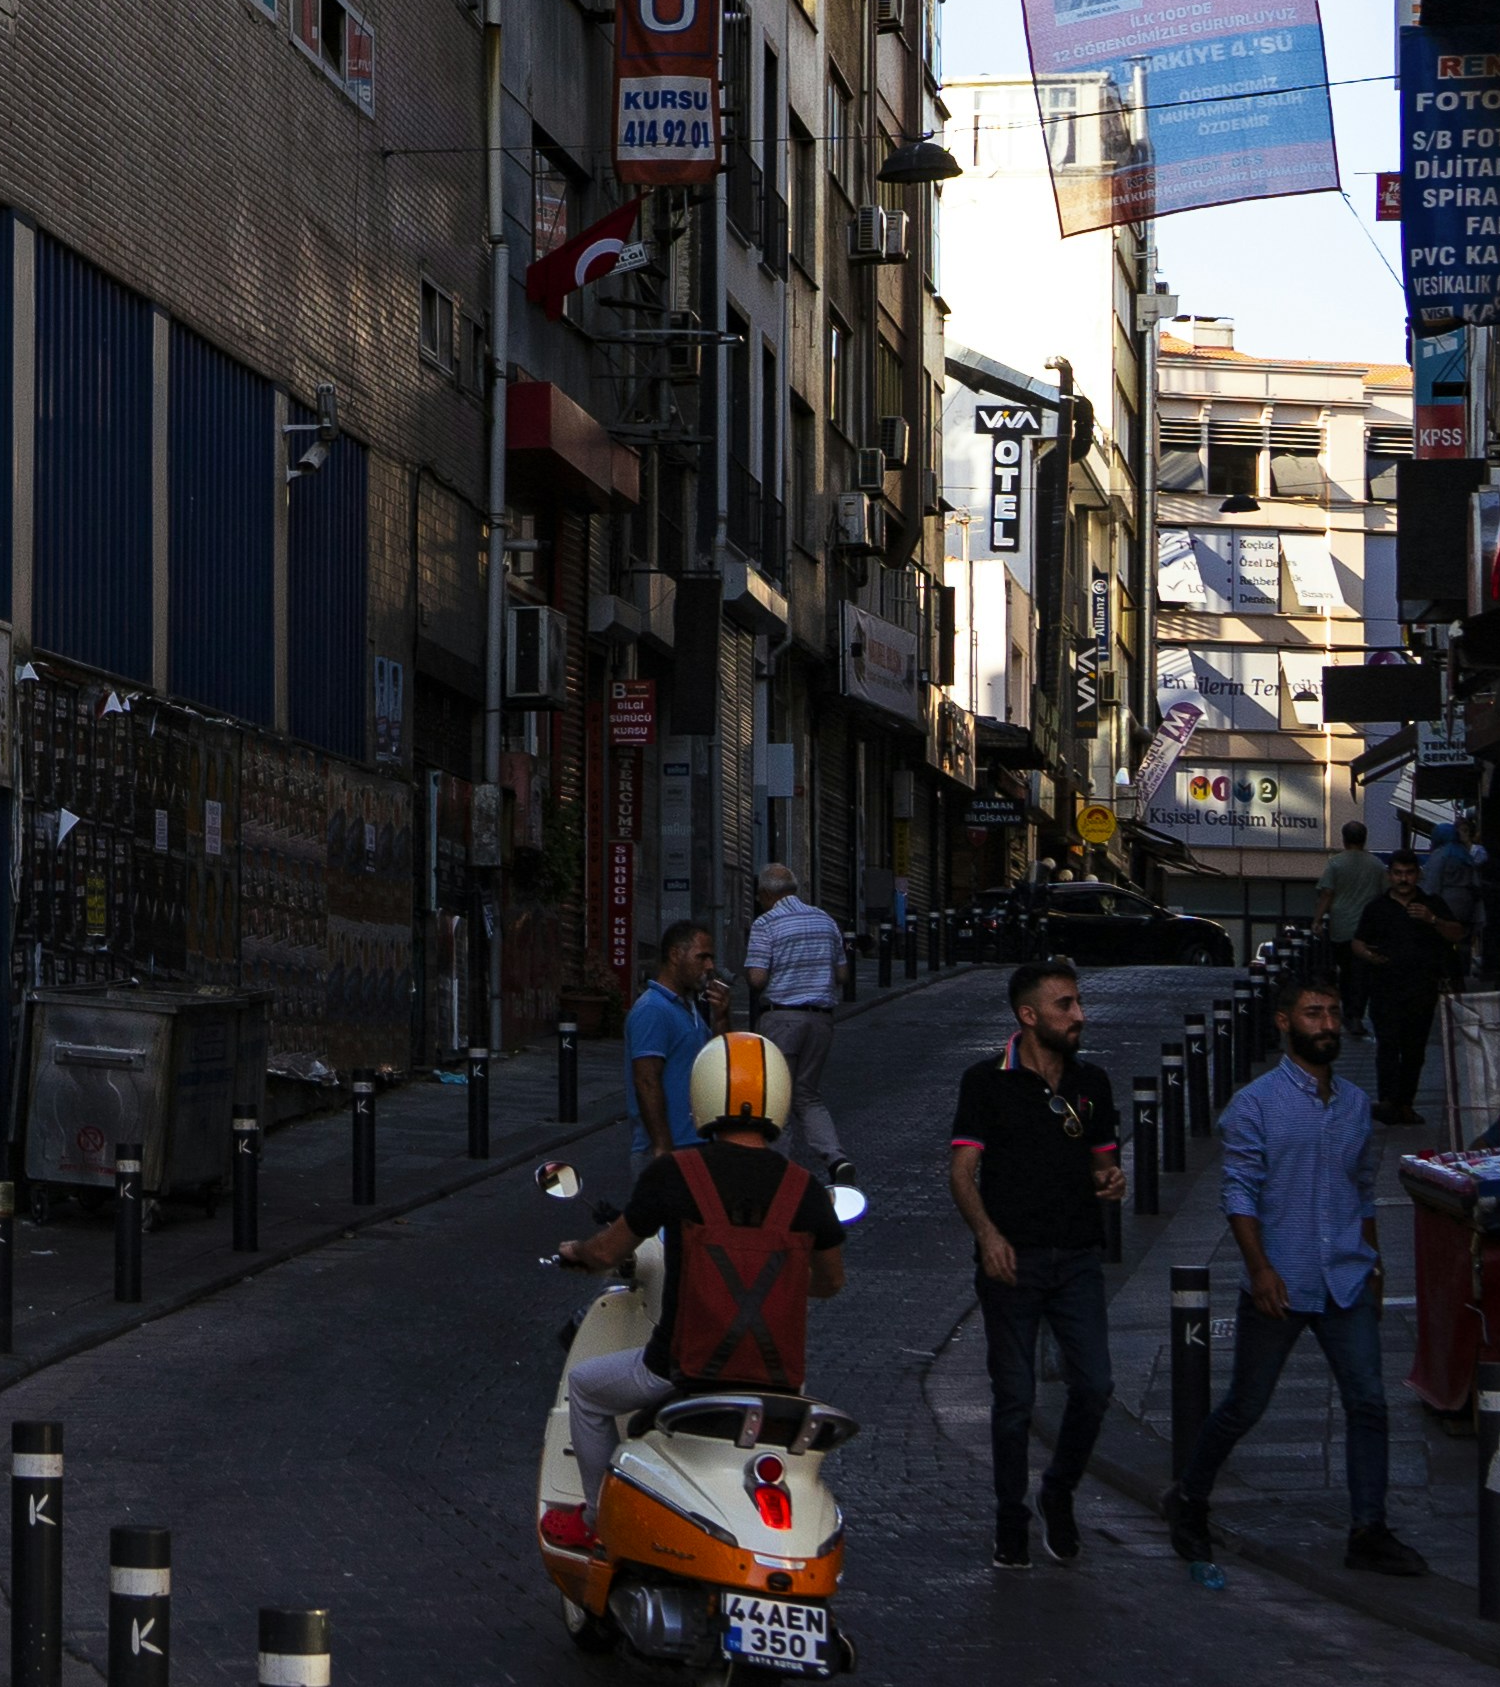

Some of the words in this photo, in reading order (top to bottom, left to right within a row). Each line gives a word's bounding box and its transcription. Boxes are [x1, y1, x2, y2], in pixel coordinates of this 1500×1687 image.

[1131, 10, 1154, 28] İLK
[624, 90, 708, 110] KURSU
[624, 120, 658, 148] 414
[663, 120, 686, 147] 92
[691, 121, 709, 149] 01
[1413, 130, 1452, 150] S/B
[1410, 246, 1456, 267] PVC
[1413, 272, 1489, 296] VESİKALIK
[1420, 429, 1462, 446] KPSS
[993, 439, 1019, 547] OTEL
[1239, 539, 1275, 551] Koçluk
[1239, 556, 1263, 568] Özel
[1095, 595, 1107, 638] Allianz
[612, 683, 626, 699] B
[1163, 674, 1188, 690] En
[617, 701, 644, 710] BİLGİ
[610, 713, 652, 723] SÜRÜCÜ
[613, 727, 648, 736] KURSU
[972, 801, 1014, 811] SALMAN
[965, 812, 1021, 823] BİLGİSAYAR
[1150, 808, 1201, 829] Kişisel
[1204, 809, 1268, 830] Gelişim
[1273, 812, 1318, 829] Kursu
[614, 845, 627, 905] SÜRÜCÜ
[614, 916, 626, 966] KURSU
[121, 1183, 133, 1199] K
[1186, 1323, 1205, 1345] K
[30, 1494, 55, 1525] K
[730, 1598, 824, 1633] 44AEN
[751, 1628, 805, 1658] 350
